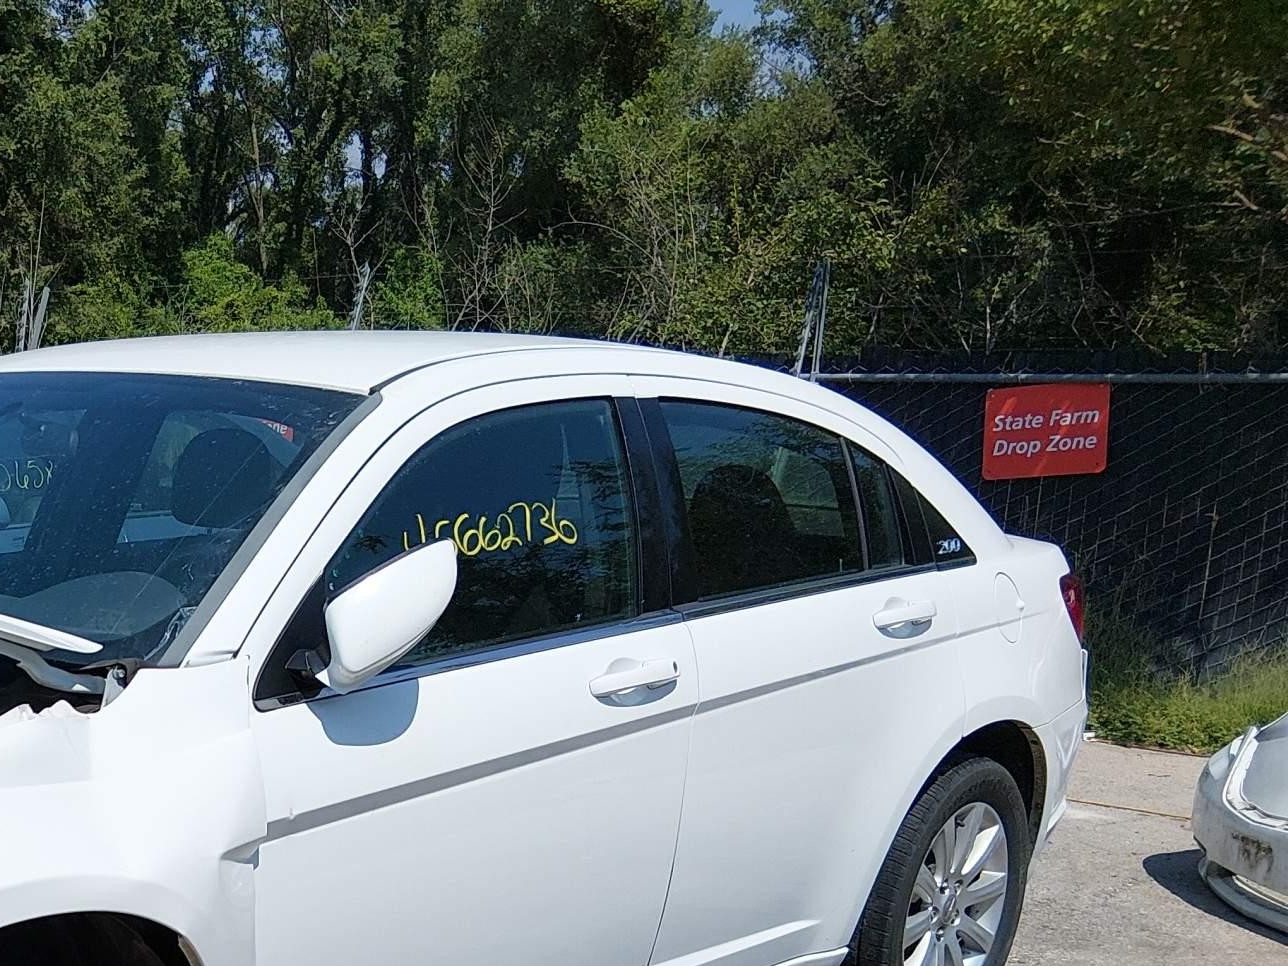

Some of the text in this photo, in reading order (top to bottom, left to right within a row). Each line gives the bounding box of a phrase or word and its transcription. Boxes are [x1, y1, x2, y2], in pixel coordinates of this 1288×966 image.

[992, 409, 1100, 431] State Farm
[993, 434, 1097, 458] Drop Zone
